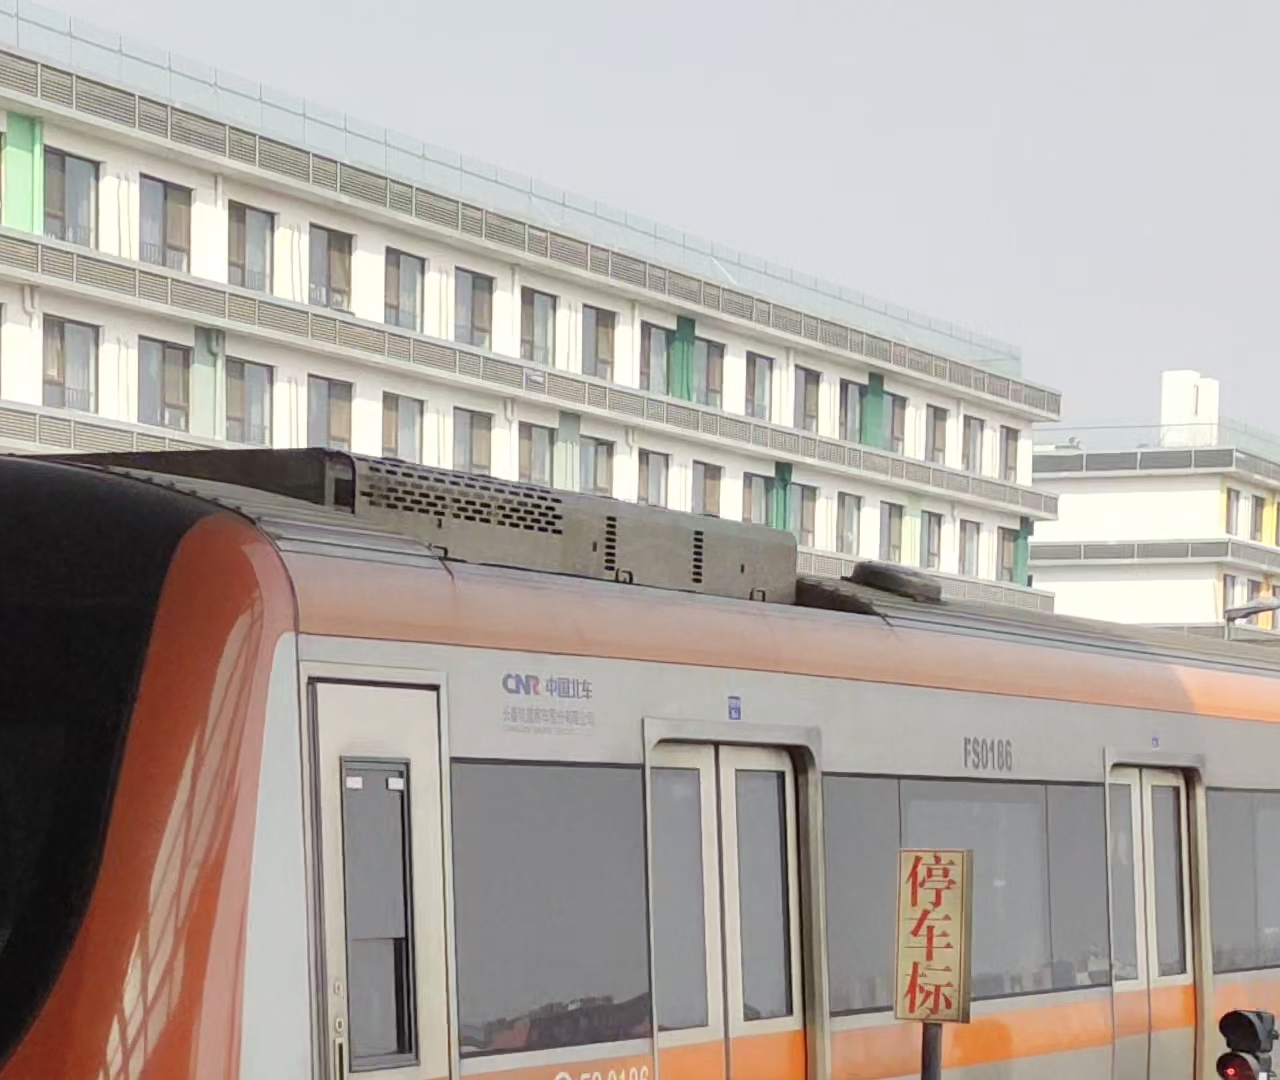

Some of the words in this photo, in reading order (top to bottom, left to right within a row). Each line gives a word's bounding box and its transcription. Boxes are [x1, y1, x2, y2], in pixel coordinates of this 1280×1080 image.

[502, 673, 540, 696] CNR
[545, 677, 593, 700] 中国北车
[963, 736, 1013, 771] FS0186
[904, 852, 957, 1017] 停车标
